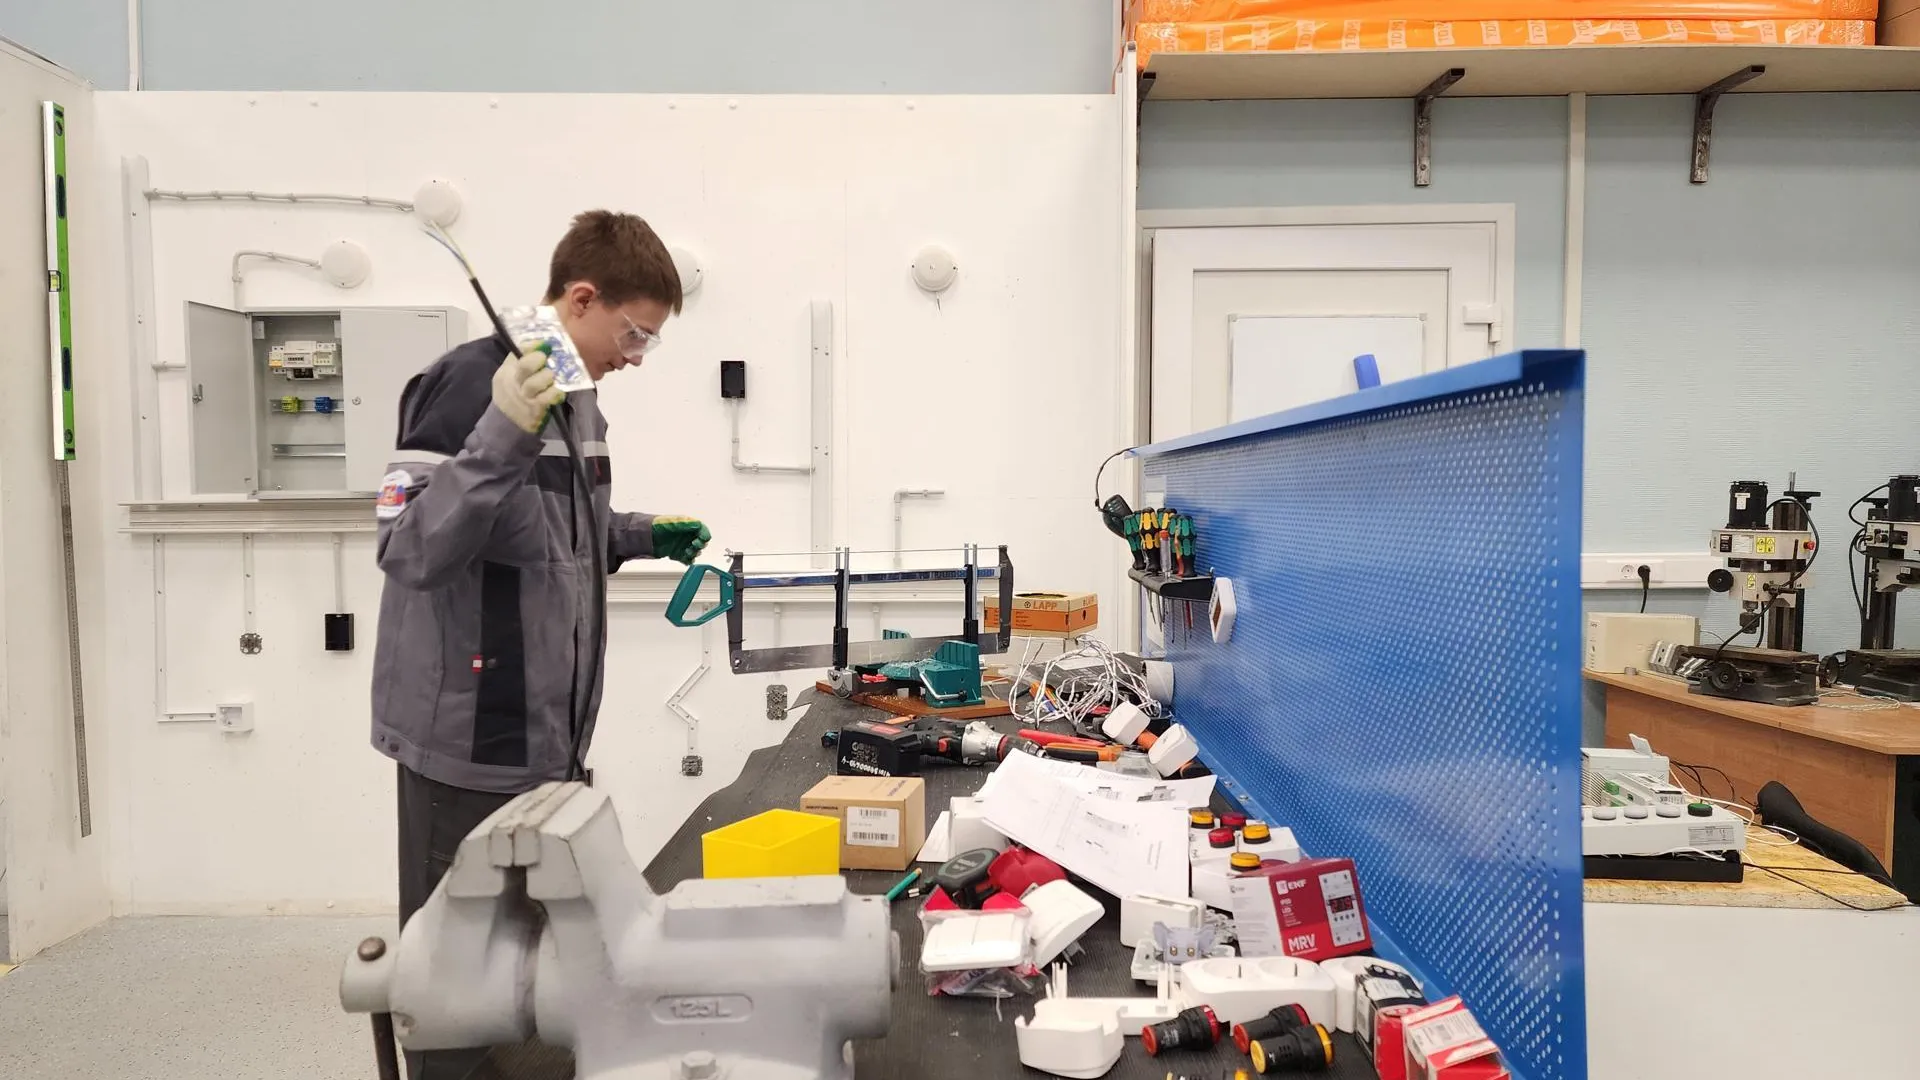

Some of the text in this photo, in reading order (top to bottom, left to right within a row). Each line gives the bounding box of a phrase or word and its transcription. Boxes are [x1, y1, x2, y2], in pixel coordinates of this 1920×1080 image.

[1391, 20, 1403, 46] TDM
[1033, 600, 1057, 610] LAPP
[1288, 933, 1315, 952] MRV
[670, 998, 731, 1018] 125L
